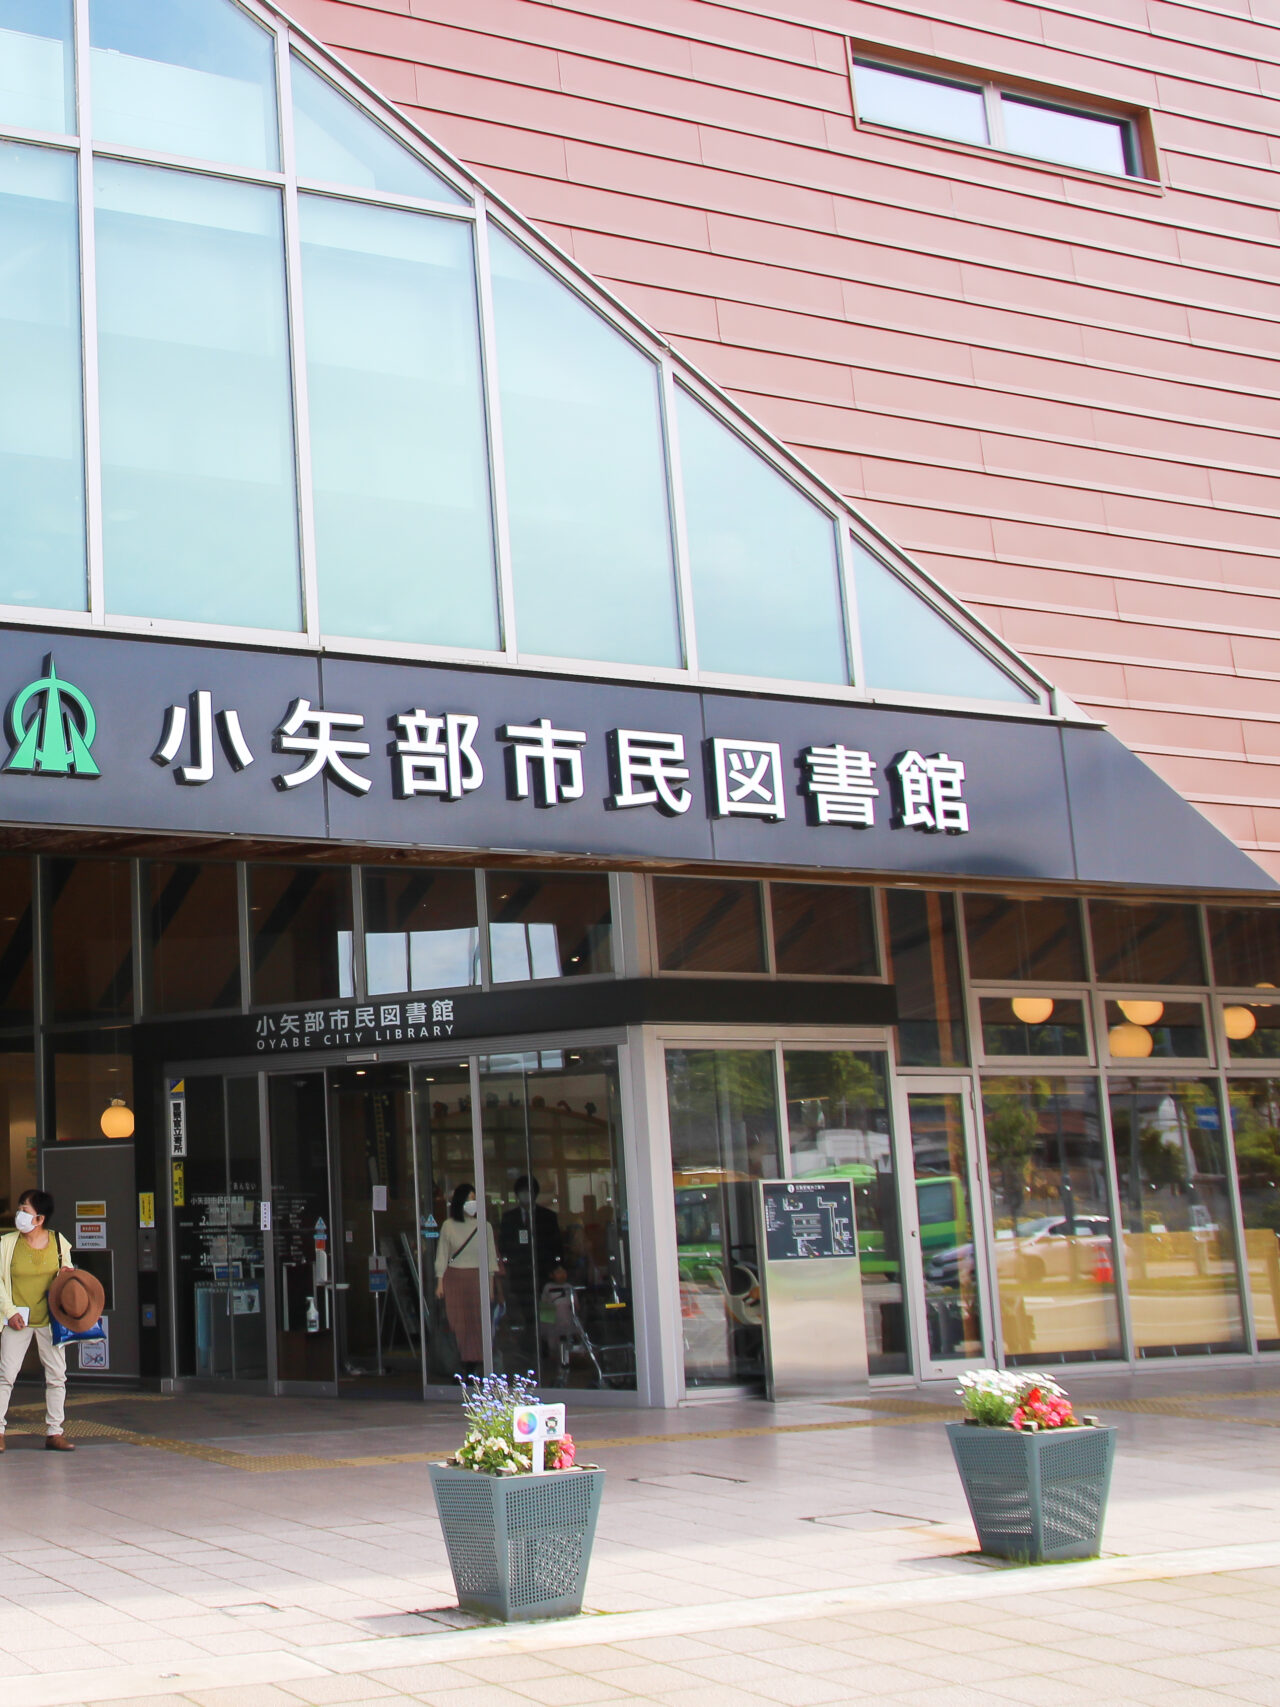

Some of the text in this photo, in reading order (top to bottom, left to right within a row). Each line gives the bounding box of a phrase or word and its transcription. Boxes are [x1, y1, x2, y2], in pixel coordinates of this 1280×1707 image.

[158, 690, 971, 834] 小矢部市民図書館
[256, 999, 454, 1036] 小矢部市民図書館
[256, 1024, 454, 1050] OYABE CITY LIBRARY
